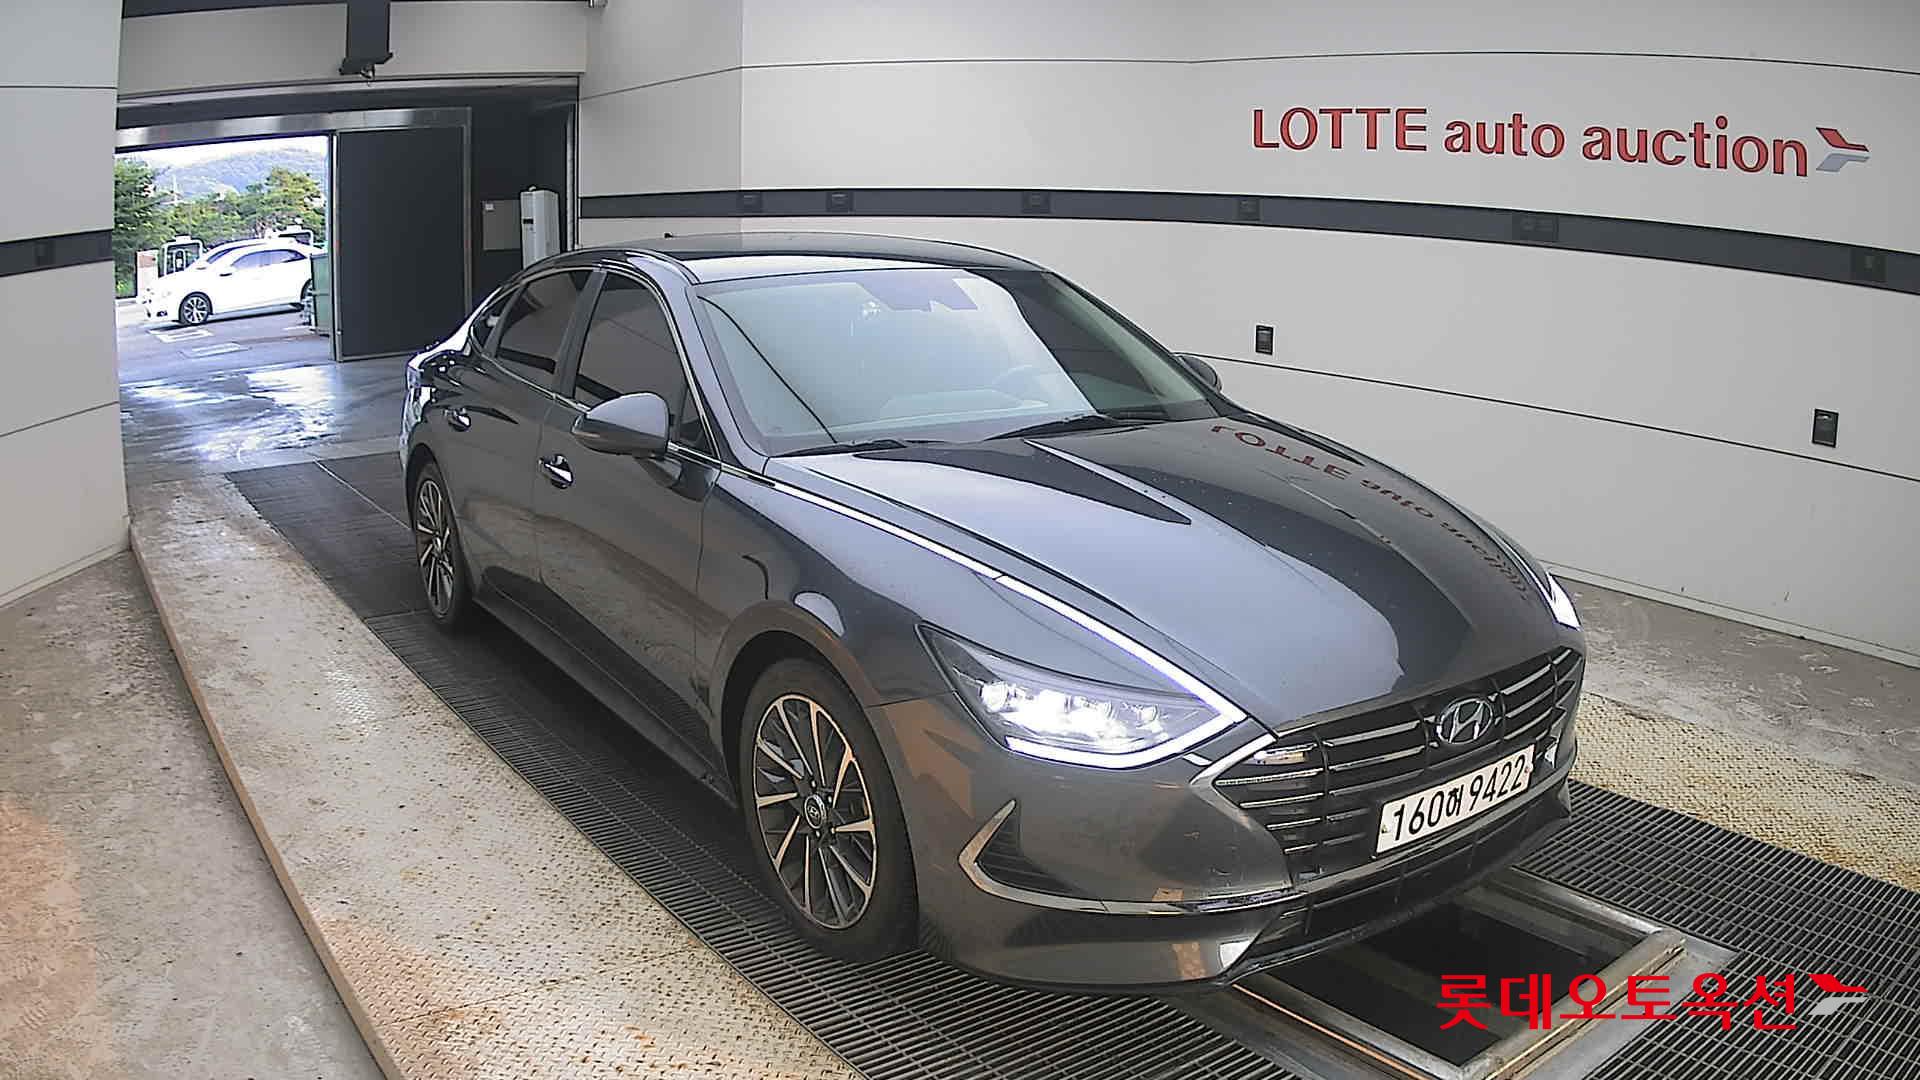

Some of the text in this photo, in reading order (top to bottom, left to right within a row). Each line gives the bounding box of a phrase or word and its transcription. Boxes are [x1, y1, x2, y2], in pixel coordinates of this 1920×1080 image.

[1252, 107, 1809, 178] LOTTE auto auction
[1393, 754, 1527, 841] 160허 9422
